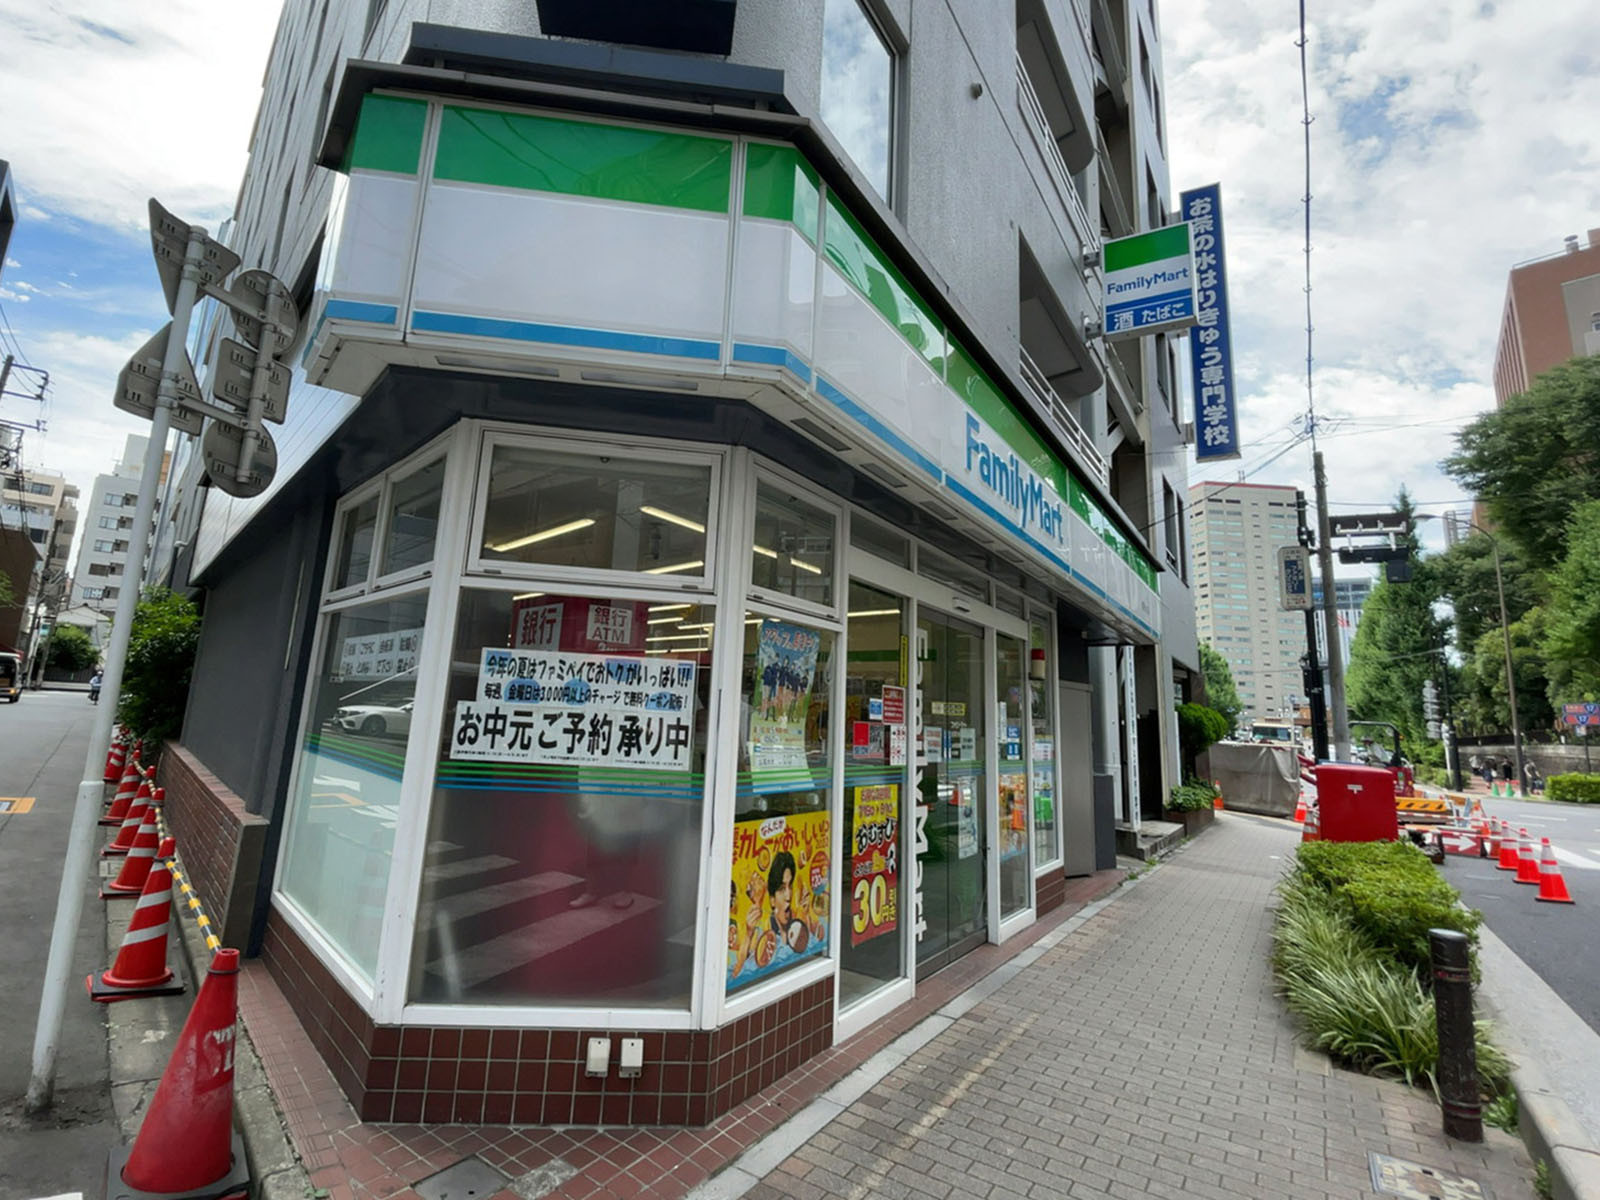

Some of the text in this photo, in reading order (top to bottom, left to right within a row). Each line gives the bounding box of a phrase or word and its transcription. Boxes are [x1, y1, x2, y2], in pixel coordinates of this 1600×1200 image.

[1107, 266, 1189, 295] FamilyMart
[1113, 302, 1186, 330] 酒 たばこ
[966, 411, 1064, 545] FamilyMart
[521, 608, 557, 646] 銀行
[594, 606, 628, 628] 銀行
[591, 626, 625, 642] ATM
[456, 706, 690, 760] お中元ご予約承り中
[853, 875, 887, 934] 30
